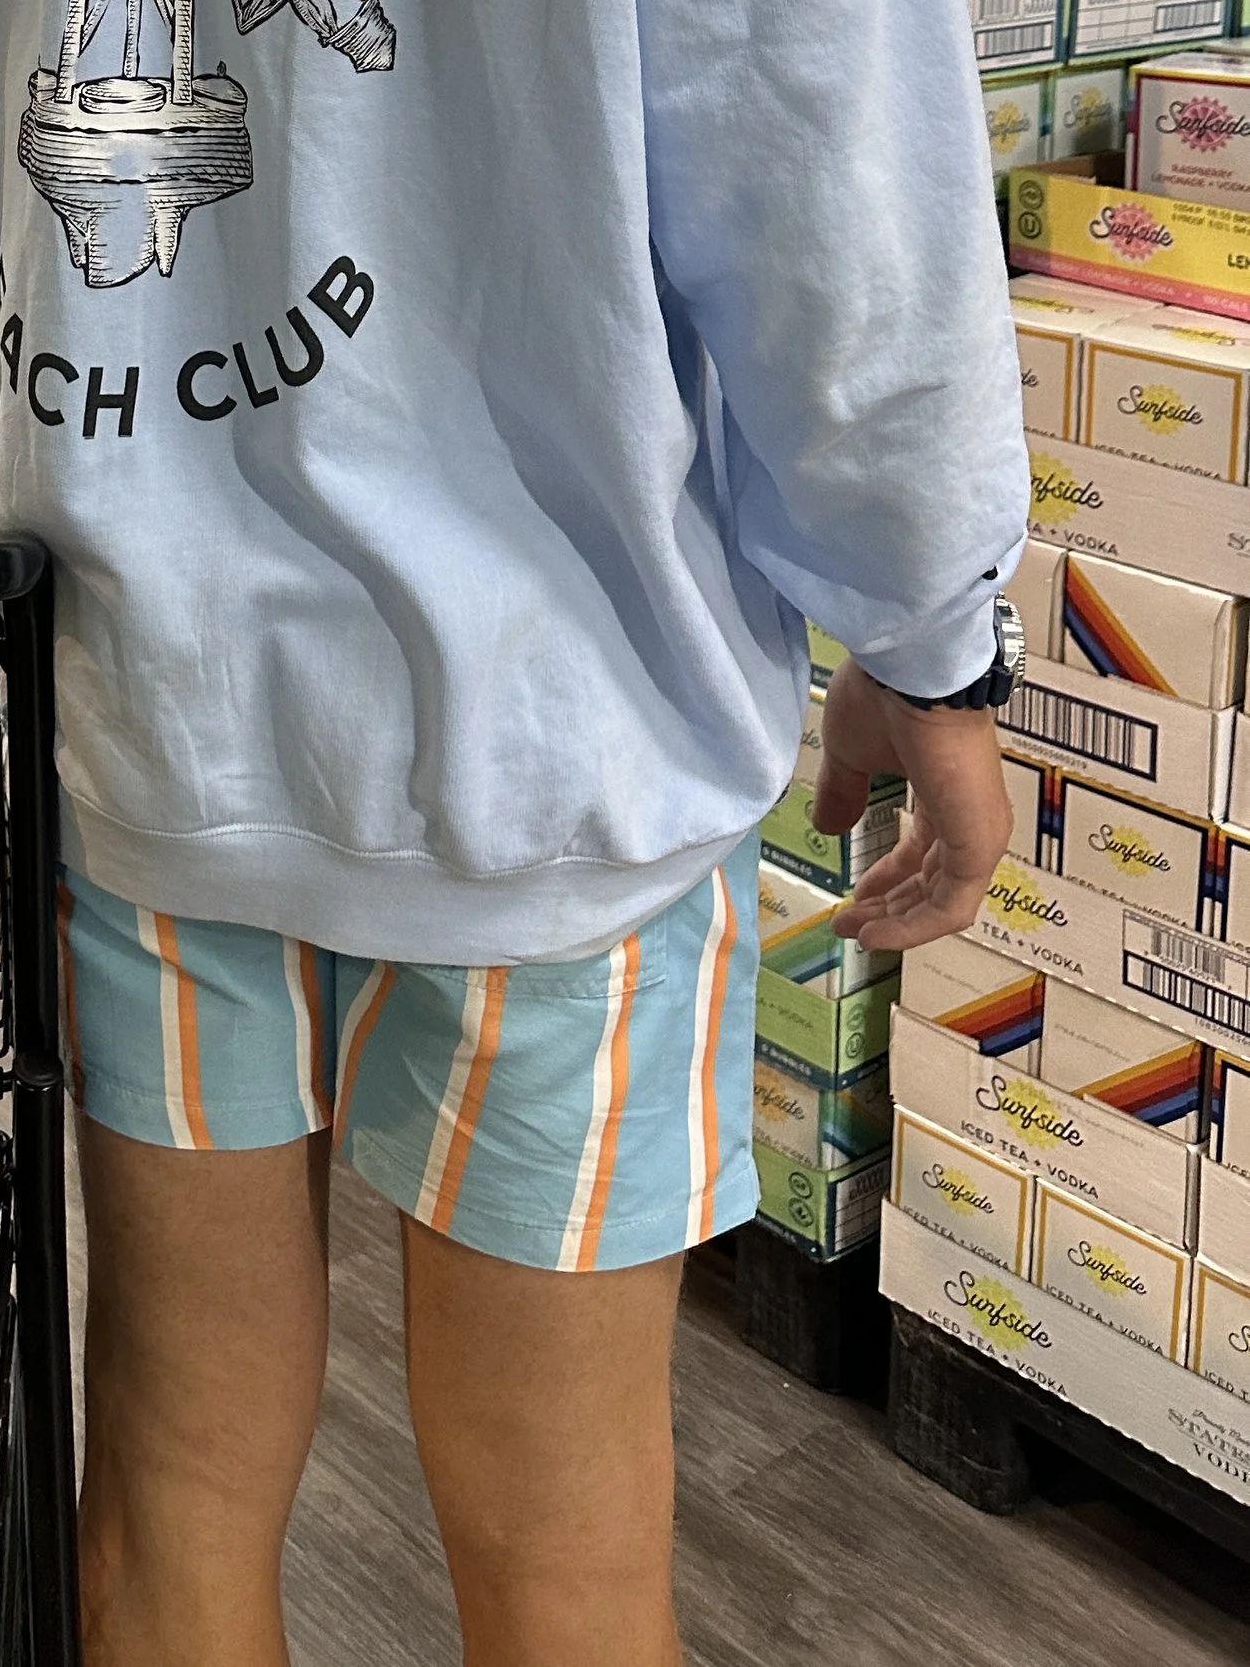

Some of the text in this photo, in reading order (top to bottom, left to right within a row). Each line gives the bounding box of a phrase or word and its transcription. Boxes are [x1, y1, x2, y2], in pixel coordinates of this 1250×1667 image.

[1155, 100, 1250, 137] Surfside
[1089, 206, 1174, 247] Surfside
[176, 254, 376, 423] CLUB
[1117, 385, 1203, 425] Surfside
[1029, 473, 1104, 510] rfside
[1064, 529, 1119, 556] VODKA
[1088, 824, 1171, 872] Surfside
[981, 921, 1011, 945] TEA
[1030, 943, 1086, 976] VODKA
[975, 1075, 1084, 1148] Surfside
[961, 1120, 993, 1145] ICED
[999, 1138, 1029, 1162] TEA
[1047, 1162, 1099, 1200] VODKA
[922, 1163, 995, 1215] Surfside
[1067, 1240, 1147, 1296] Surfside
[943, 1270, 1053, 1348] Surfside
[1044, 1283, 1074, 1307] ICED
[1119, 1324, 1165, 1355] VODKA
[927, 1308, 961, 1335] ICED
[966, 1331, 995, 1356] TEA
[1013, 1355, 1068, 1397] VODKA
[1204, 1368, 1235, 1394] ICED
